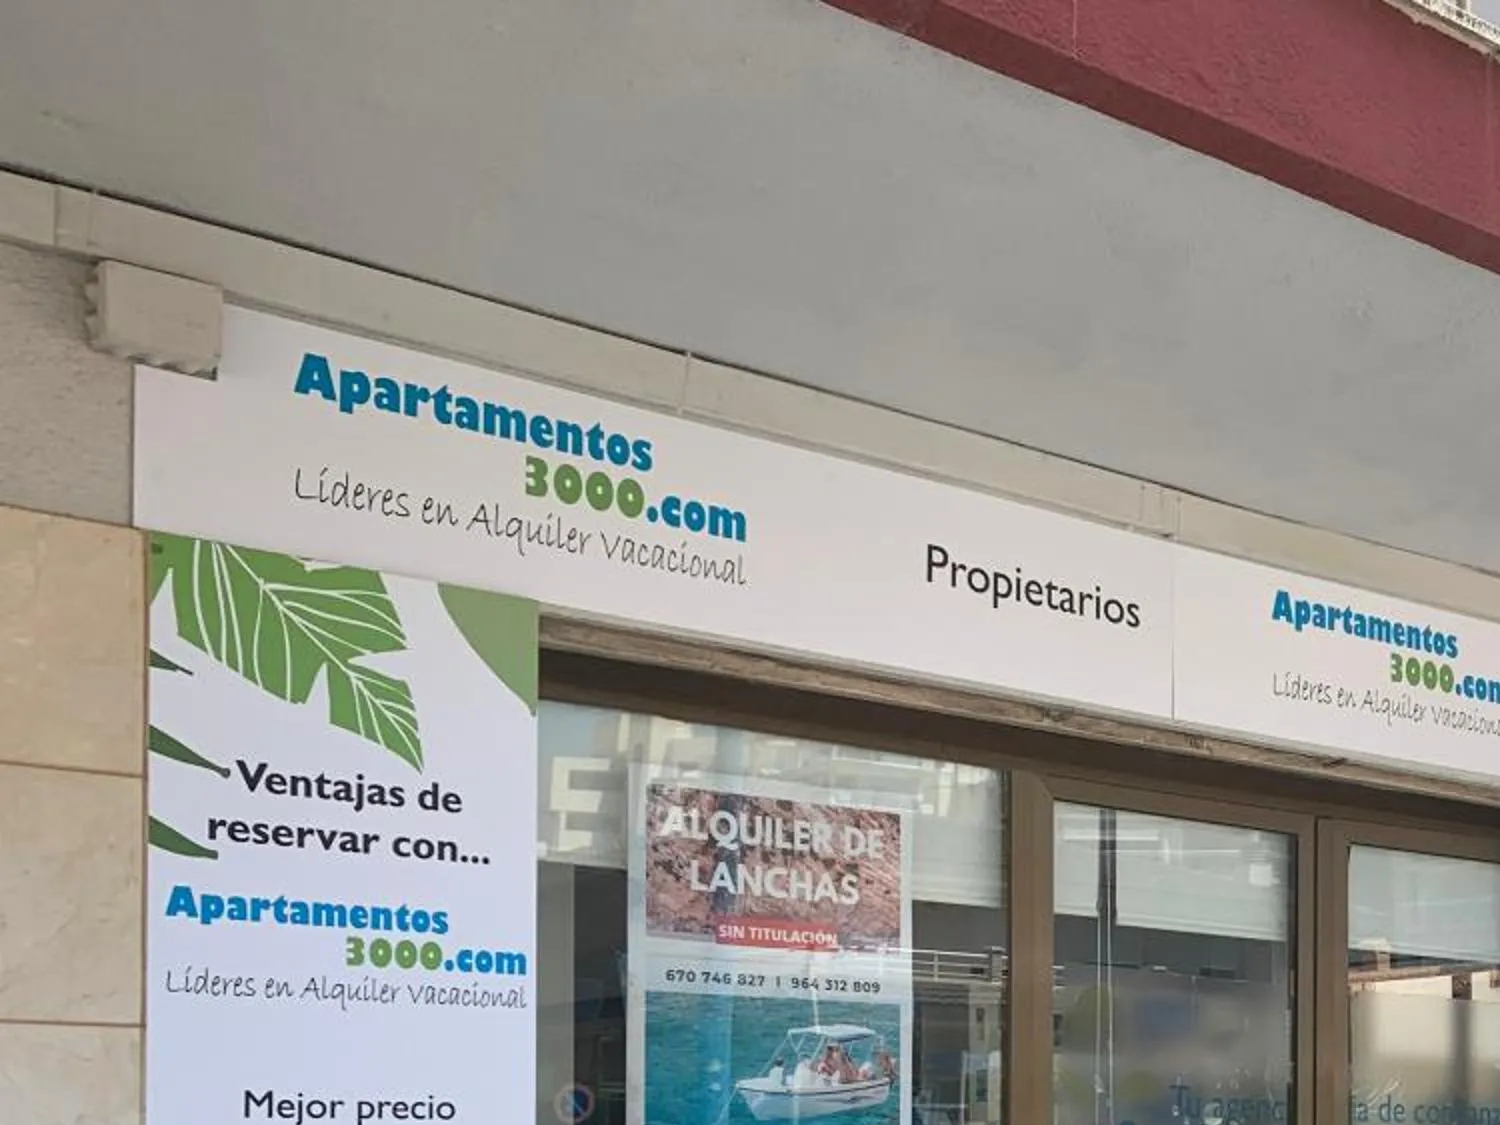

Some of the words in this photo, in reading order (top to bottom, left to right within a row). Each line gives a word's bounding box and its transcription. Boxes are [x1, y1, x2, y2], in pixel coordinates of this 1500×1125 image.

[294, 352, 653, 471] Apartamentos
[524, 455, 747, 543] 3000.com
[294, 467, 411, 519] Líderes
[421, 493, 459, 530] en
[467, 502, 592, 556] Alquiler
[600, 530, 748, 586] Vacacional
[926, 543, 1141, 628] Propietarios
[1271, 588, 1458, 659] Apartamentos
[1272, 671, 1333, 705] Líderes
[1337, 688, 1357, 708] en
[1360, 690, 1427, 726] Alquiler
[236, 759, 405, 813] Ventajas
[417, 782, 463, 814] de
[207, 816, 380, 854] reservar
[391, 835, 491, 866] con...
[656, 804, 834, 856] ALQUILER
[843, 825, 884, 860] DE
[165, 884, 450, 934] Apartamentos
[690, 861, 861, 906] LANCHAS
[345, 936, 527, 977] 3000.com
[718, 923, 746, 939] SIN
[749, 926, 838, 946] TITULACIÓN
[165, 965, 257, 1000] Líderes
[265, 977, 291, 999] en
[299, 972, 400, 1011] Alquiler
[408, 979, 528, 1009] Vacacional
[665, 969, 696, 983] 670
[701, 971, 731, 985] 746
[791, 977, 819, 990] 964
[825, 979, 847, 992] 312
[1378, 1095, 1406, 1123] de
